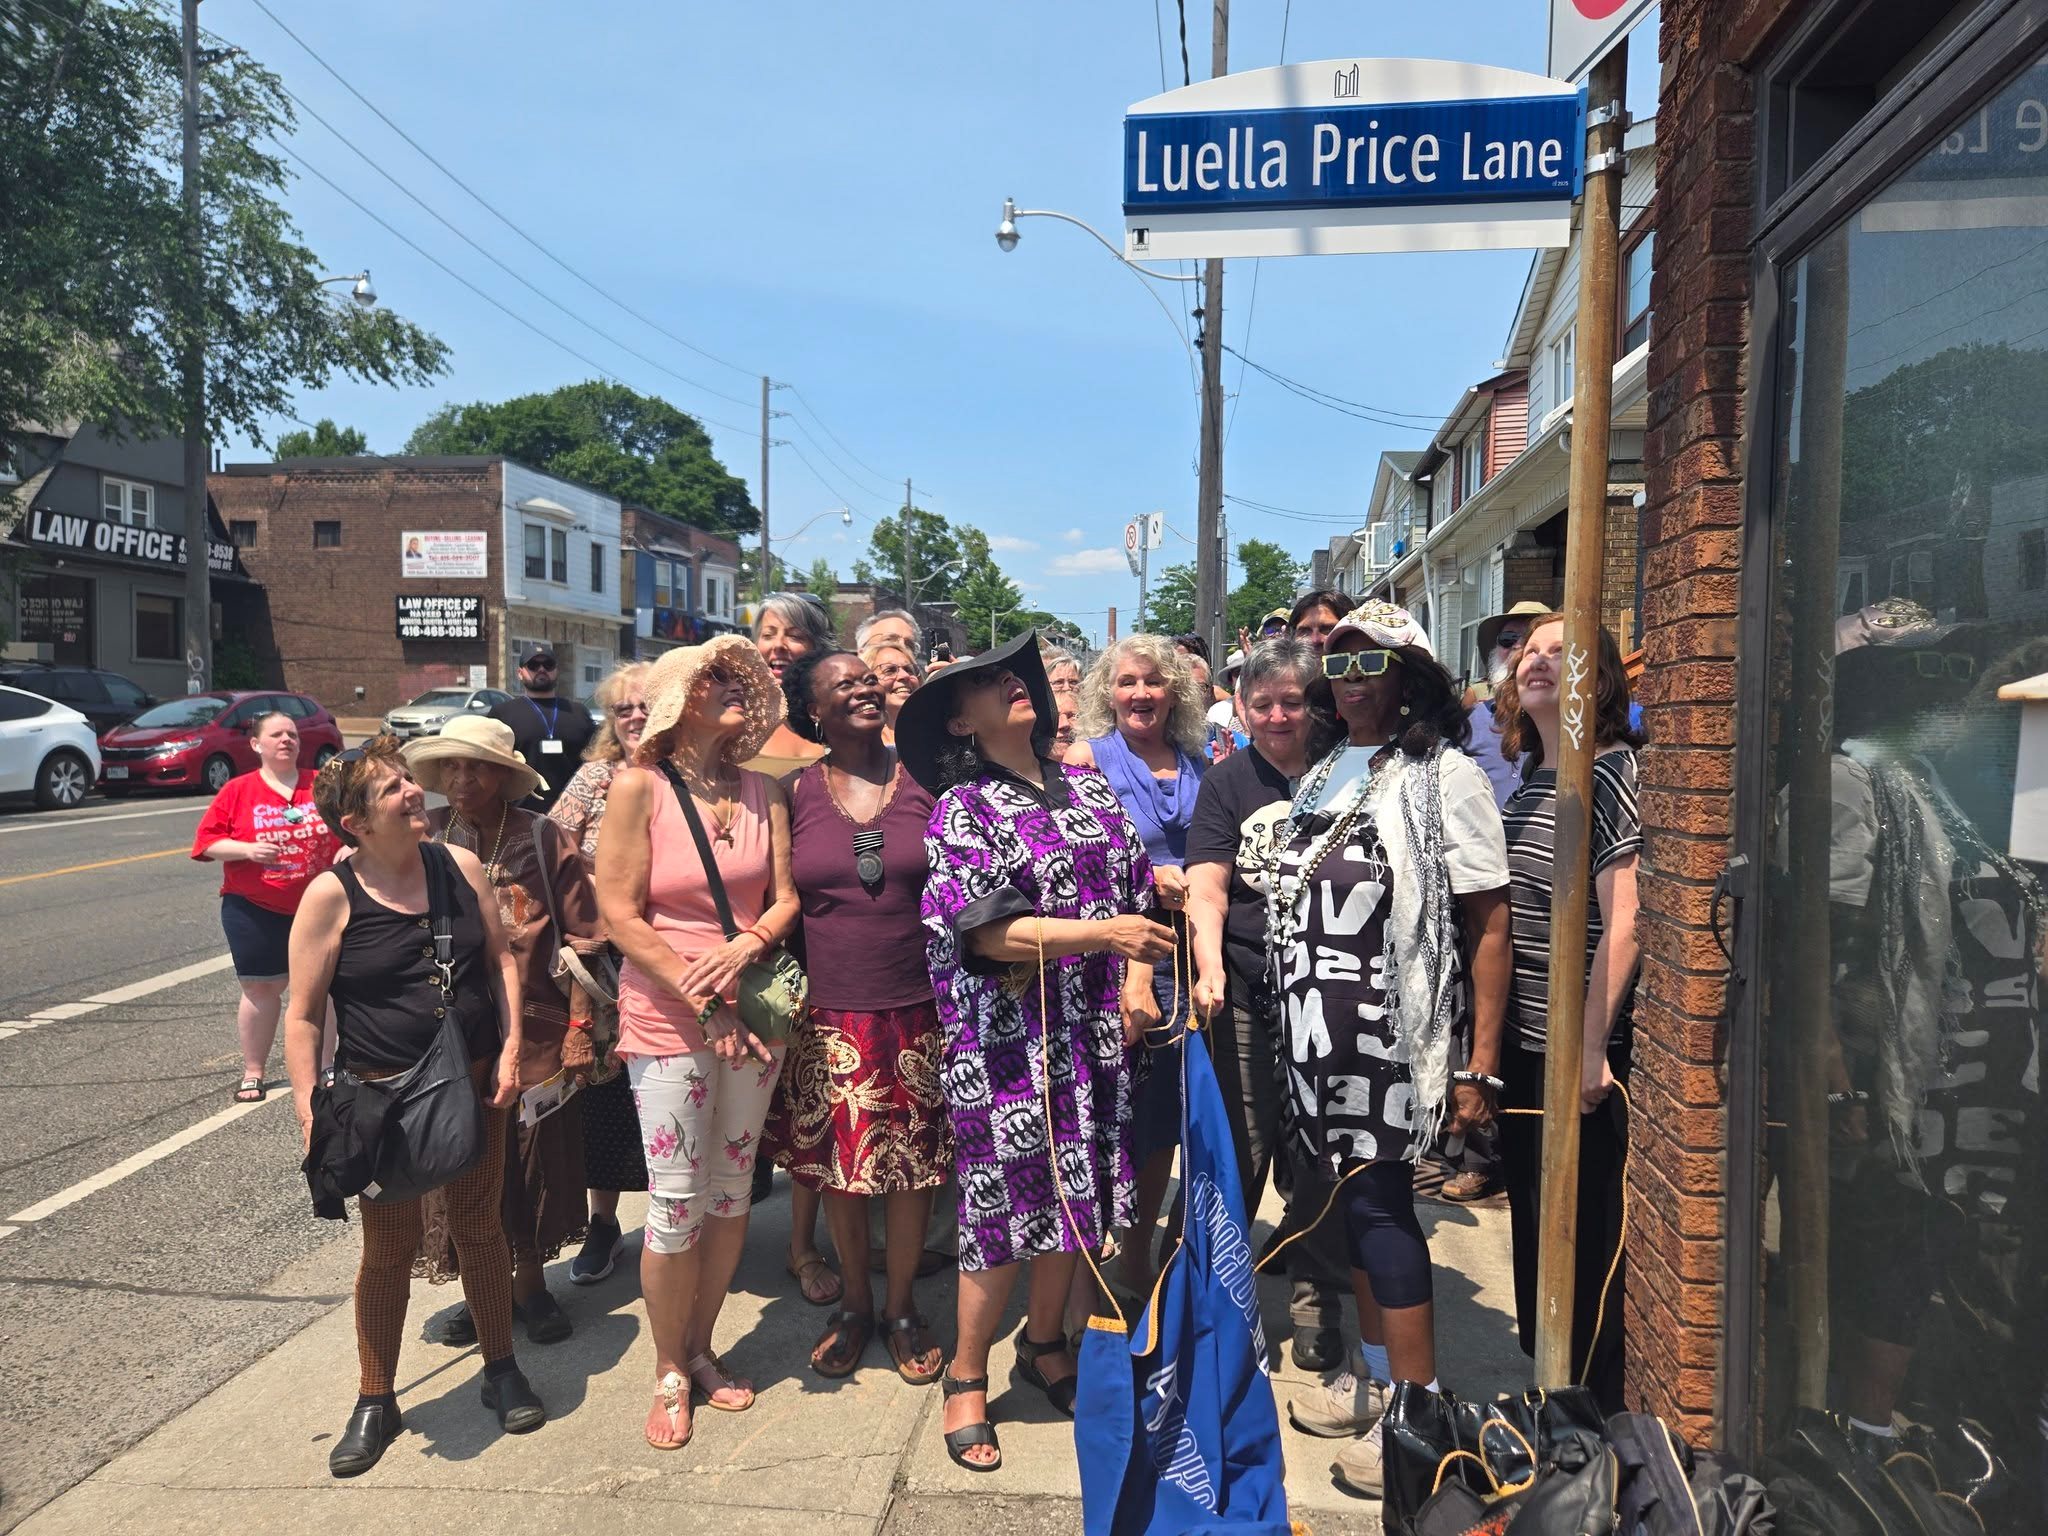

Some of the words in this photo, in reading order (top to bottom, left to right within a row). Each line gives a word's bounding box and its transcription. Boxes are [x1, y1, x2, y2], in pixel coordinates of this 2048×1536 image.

[1137, 126, 1288, 193] Luella
[1312, 120, 1440, 187] Price
[1462, 131, 1563, 181] Lane
[32, 510, 89, 547] LAW
[94, 522, 174, 562] OFFICE
[399, 597, 422, 610] LAW
[423, 597, 461, 611] OFFICE
[462, 598, 478, 611] OF
[255, 830, 291, 846] cup
[293, 823, 314, 840] at
